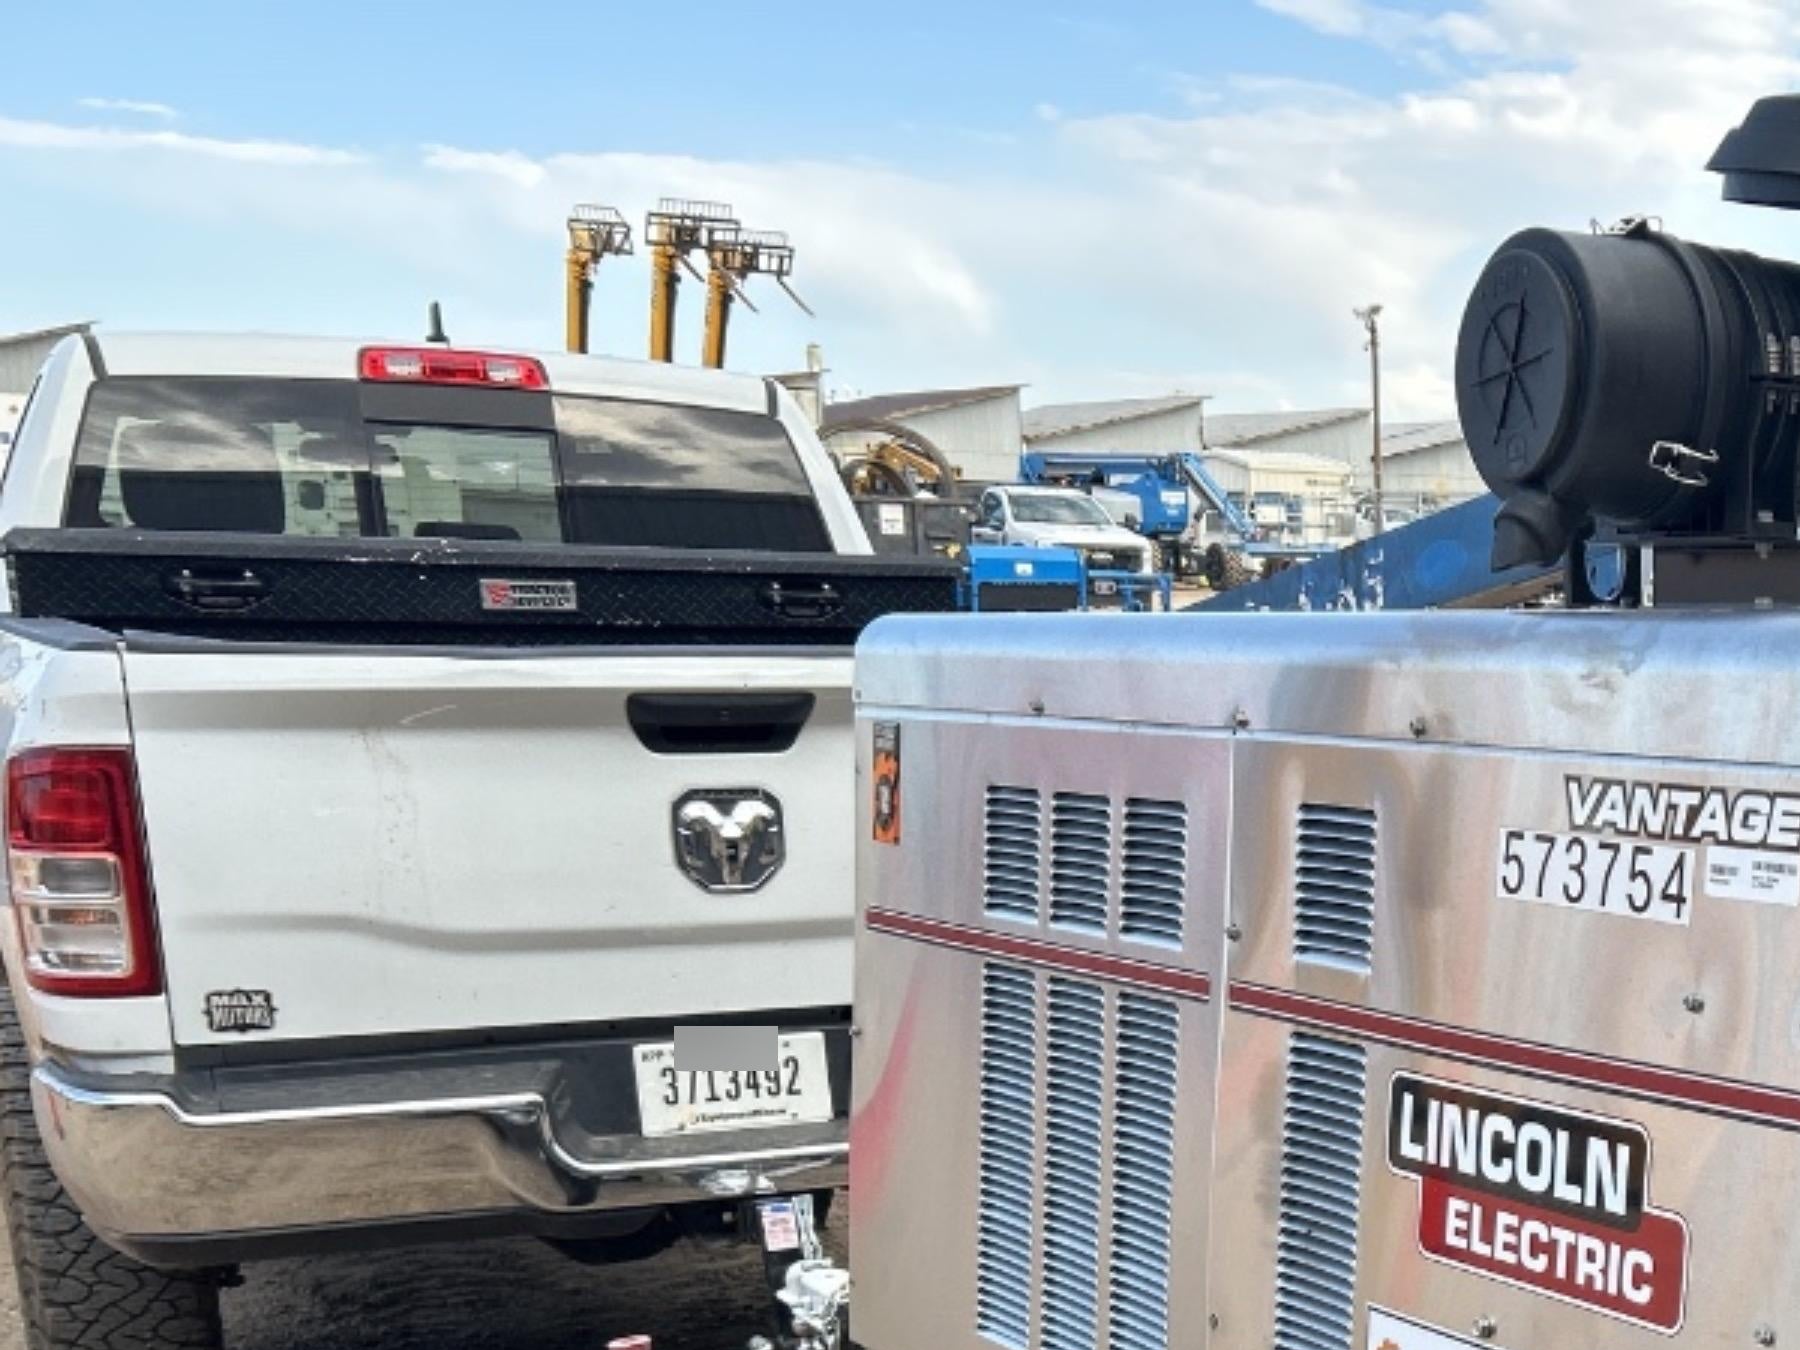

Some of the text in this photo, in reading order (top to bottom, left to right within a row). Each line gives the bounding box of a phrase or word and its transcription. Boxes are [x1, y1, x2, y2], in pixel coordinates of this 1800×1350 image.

[1501, 830, 1688, 920] 573754
[209, 991, 268, 1007] MAX
[1399, 1091, 1631, 1217] LINCOLN
[1444, 1195, 1655, 1306] ELECTRIC
